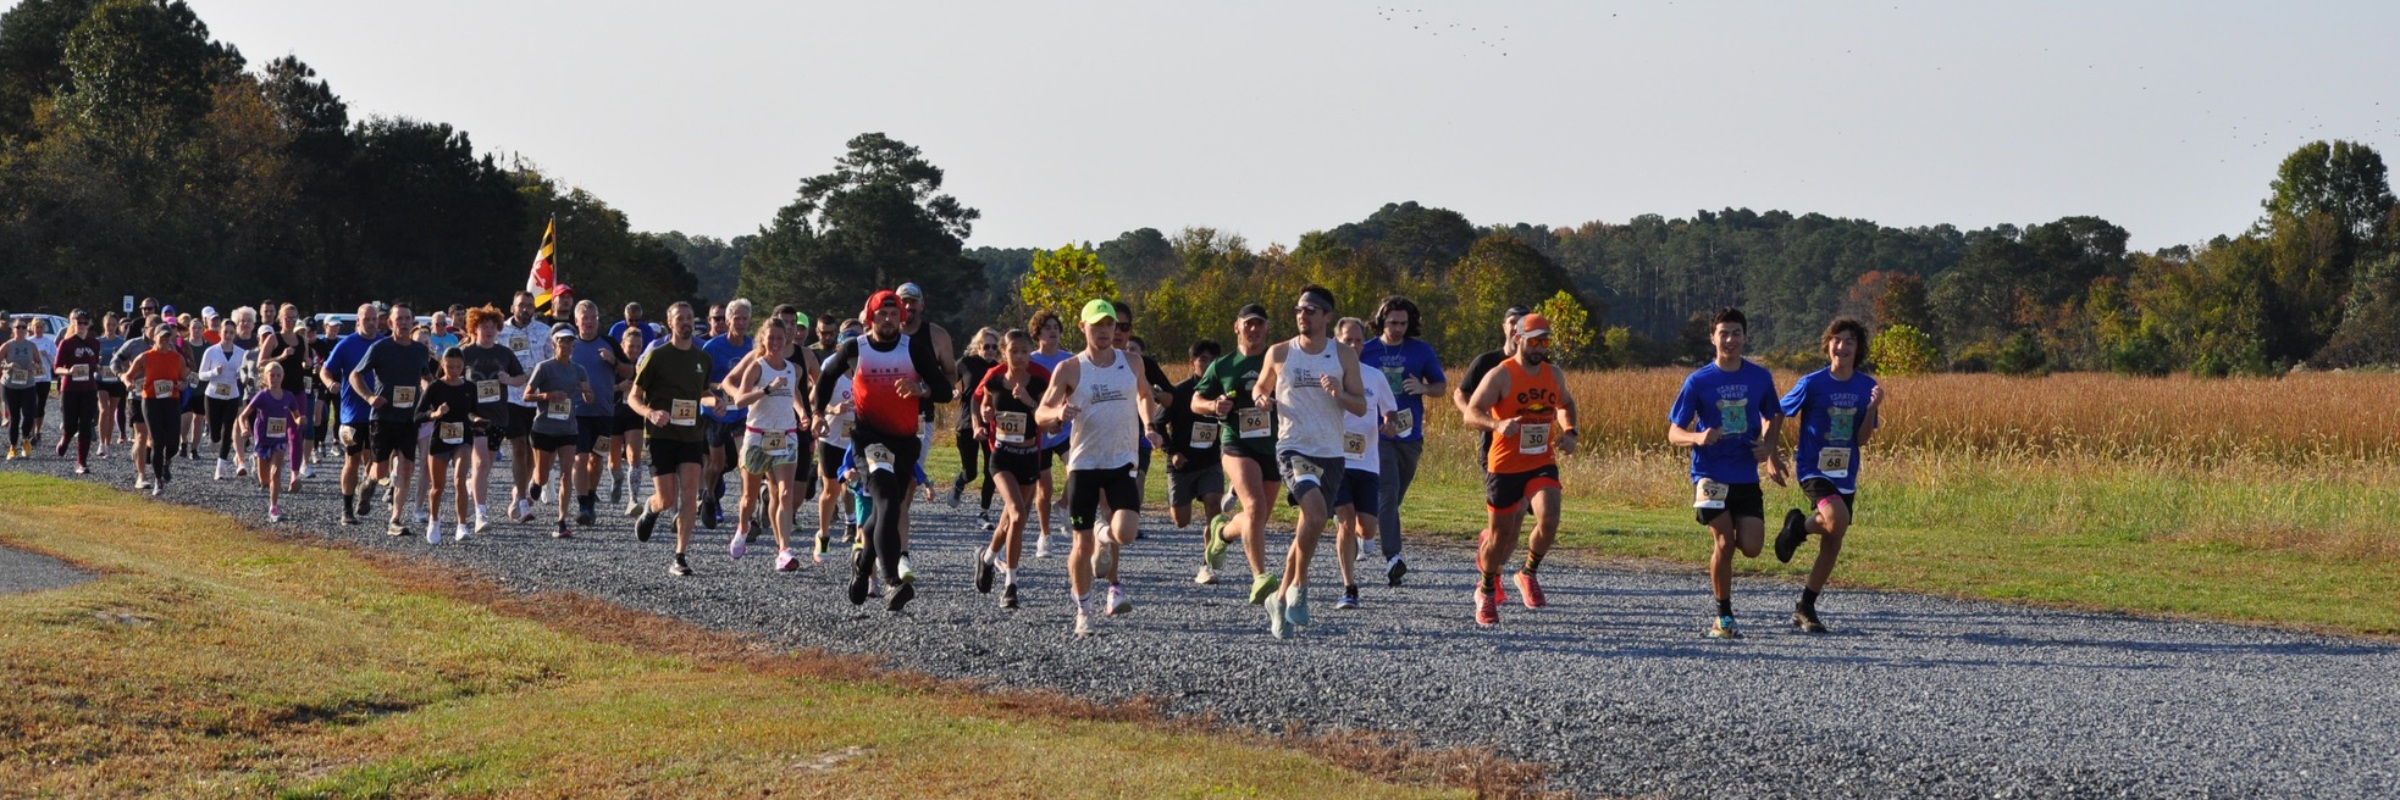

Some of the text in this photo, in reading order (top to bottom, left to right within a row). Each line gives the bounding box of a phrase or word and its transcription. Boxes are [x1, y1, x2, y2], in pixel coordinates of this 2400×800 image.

[400, 393, 410, 401] 32
[1517, 388, 1556, 404] esrc
[680, 408, 691, 417] 12
[1001, 422, 1019, 432] 101
[1247, 417, 1261, 427] 96
[1199, 431, 1211, 440] 90
[1529, 434, 1543, 444] 30
[769, 438, 781, 447] 47
[1349, 440, 1361, 450] 95
[873, 450, 888, 460] 94
[1003, 445, 1025, 455] NIKE
[1302, 463, 1316, 472] 92
[1826, 459, 1841, 468] 68
